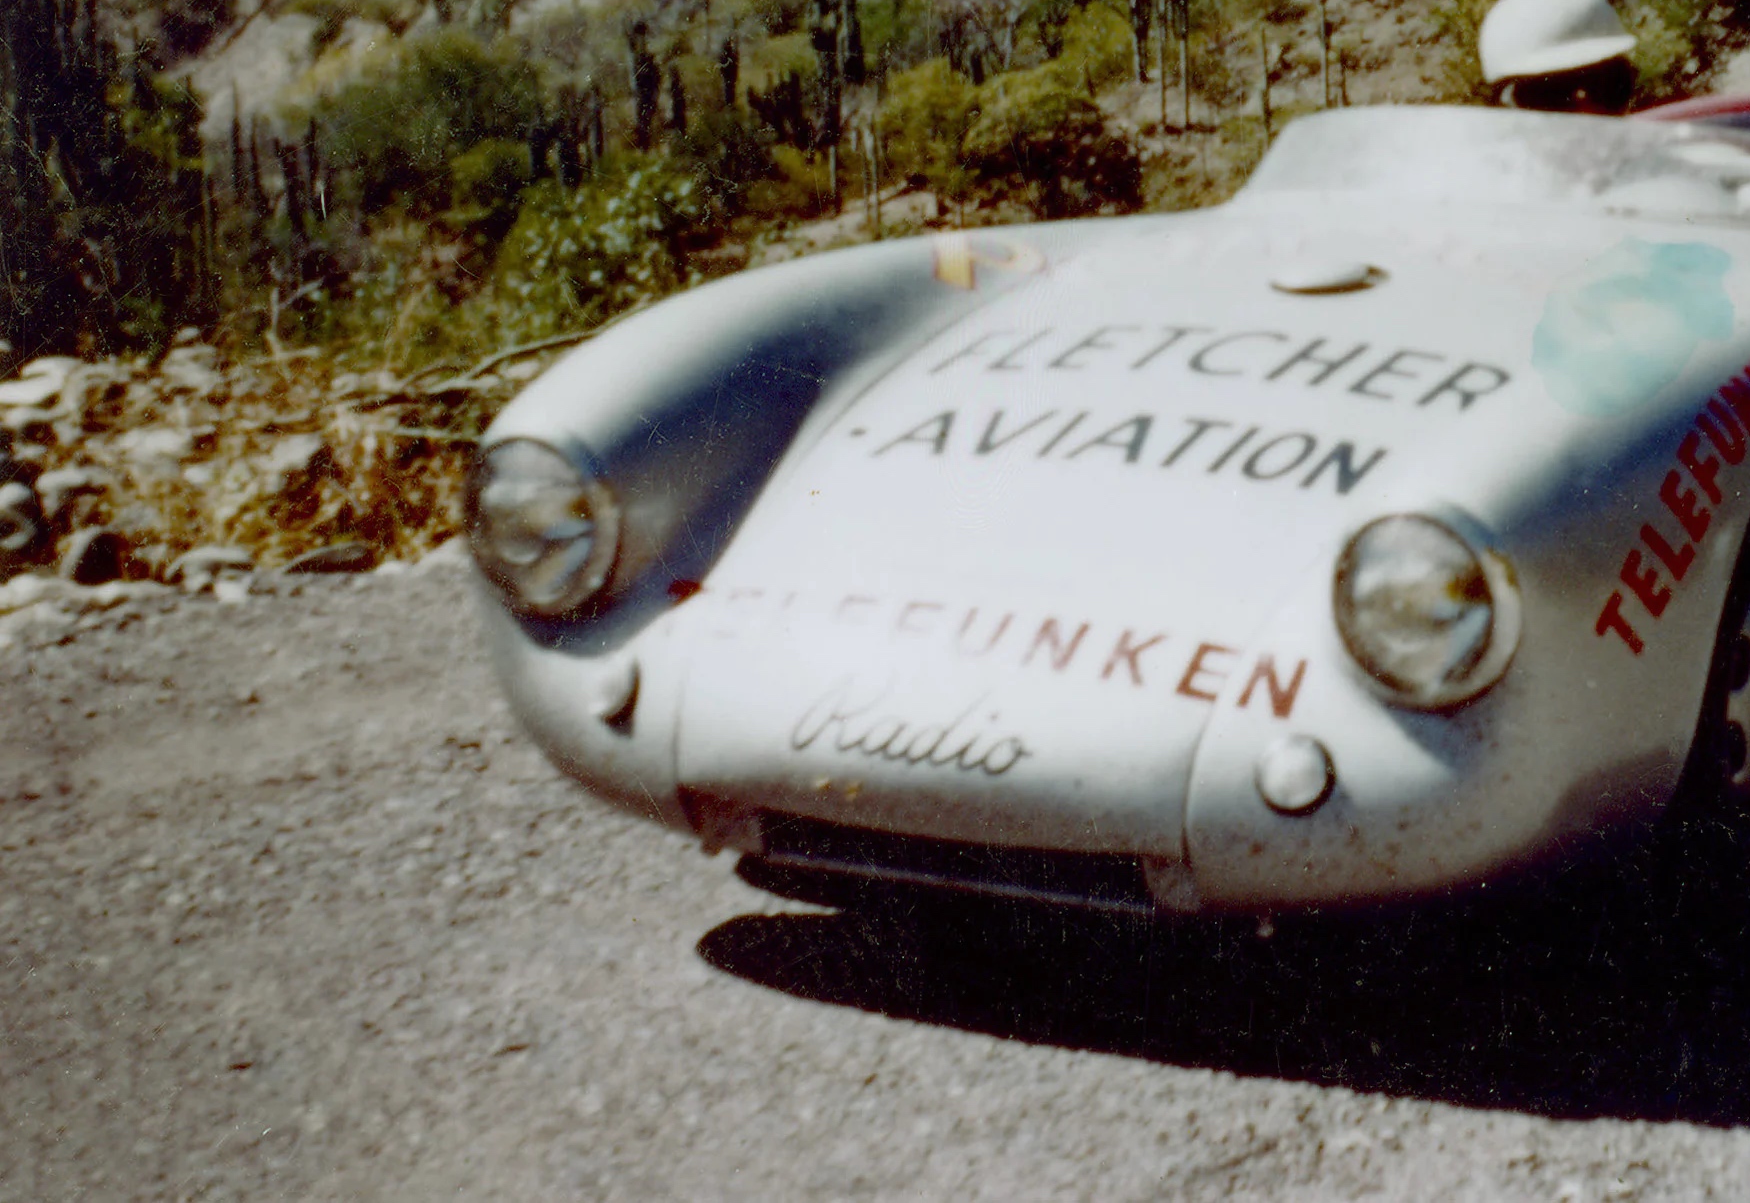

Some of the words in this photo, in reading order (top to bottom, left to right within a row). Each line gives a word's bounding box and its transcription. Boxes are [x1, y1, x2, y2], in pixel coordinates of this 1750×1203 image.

[928, 324, 1512, 411] FLETCHER
[872, 409, 1389, 496] AVIATION
[790, 673, 1034, 776] Radio
